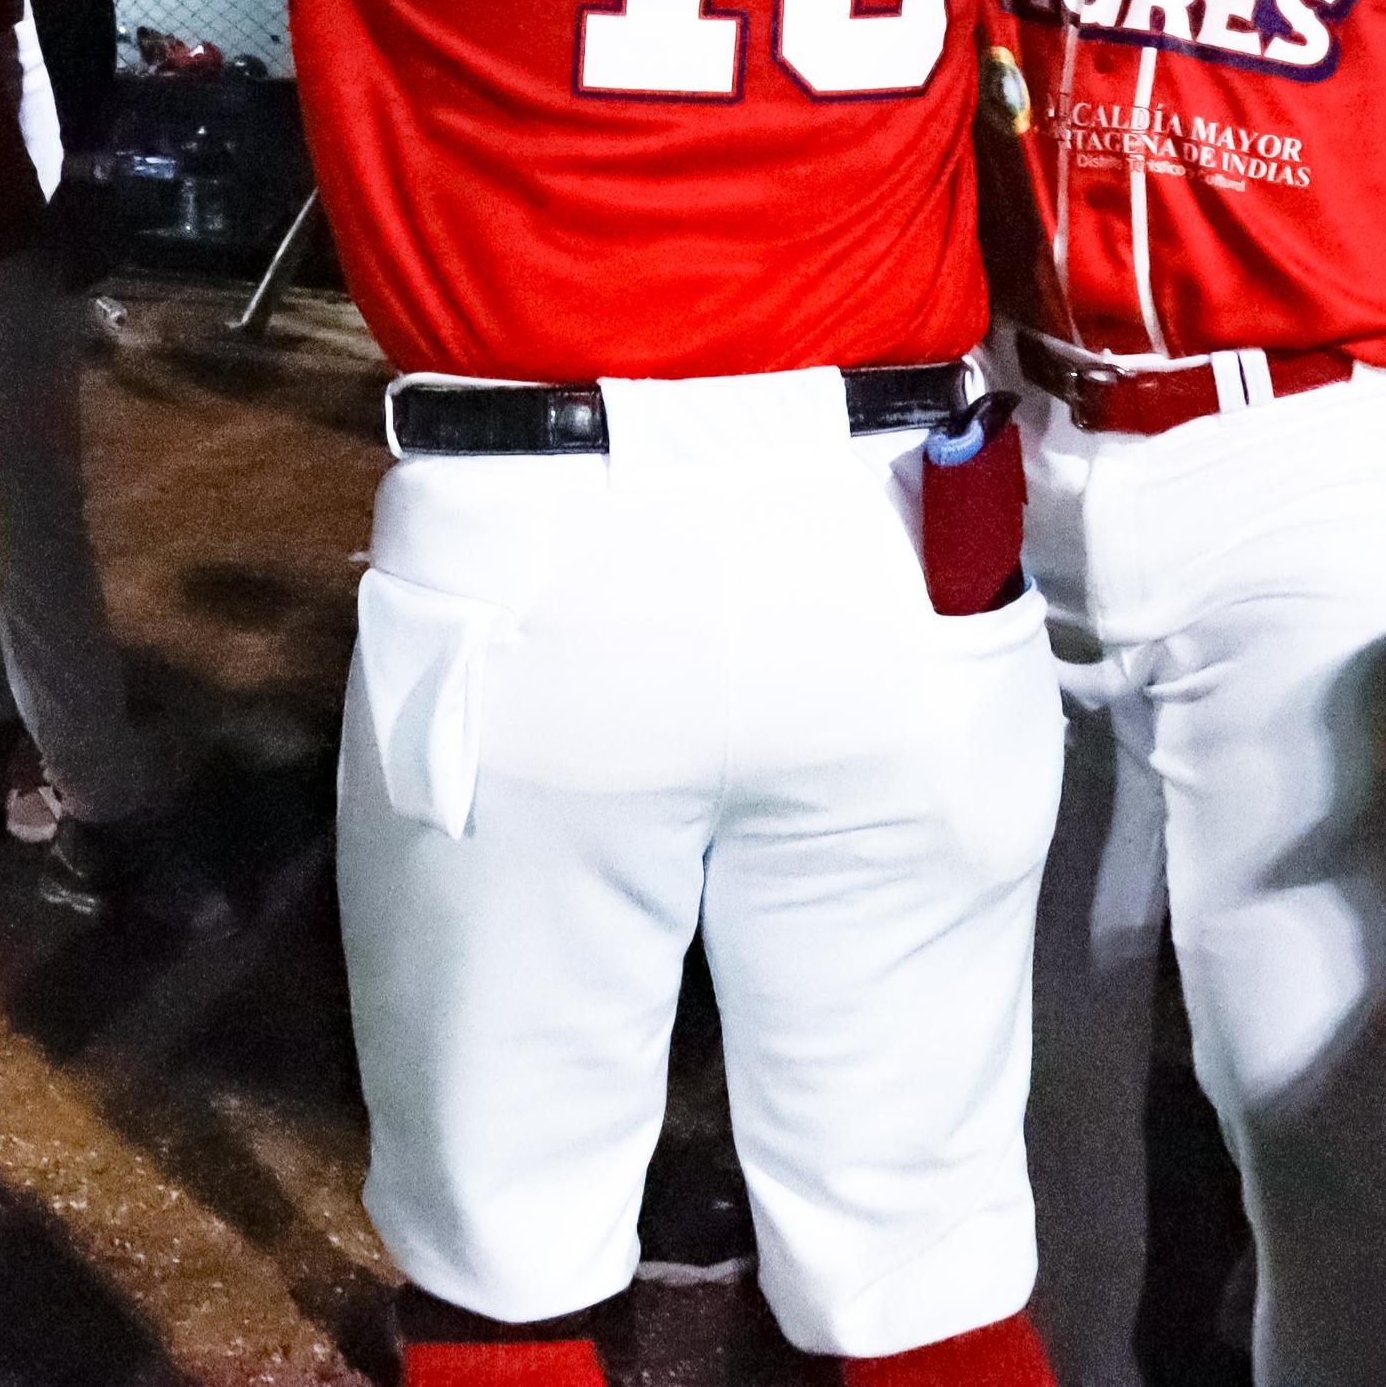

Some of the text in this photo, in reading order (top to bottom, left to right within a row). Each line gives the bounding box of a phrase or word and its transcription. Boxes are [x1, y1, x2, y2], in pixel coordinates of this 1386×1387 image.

[1190, 116, 1303, 163] MAYOR
[1182, 142, 1216, 169] DE
[1221, 151, 1312, 189] INDIAS
